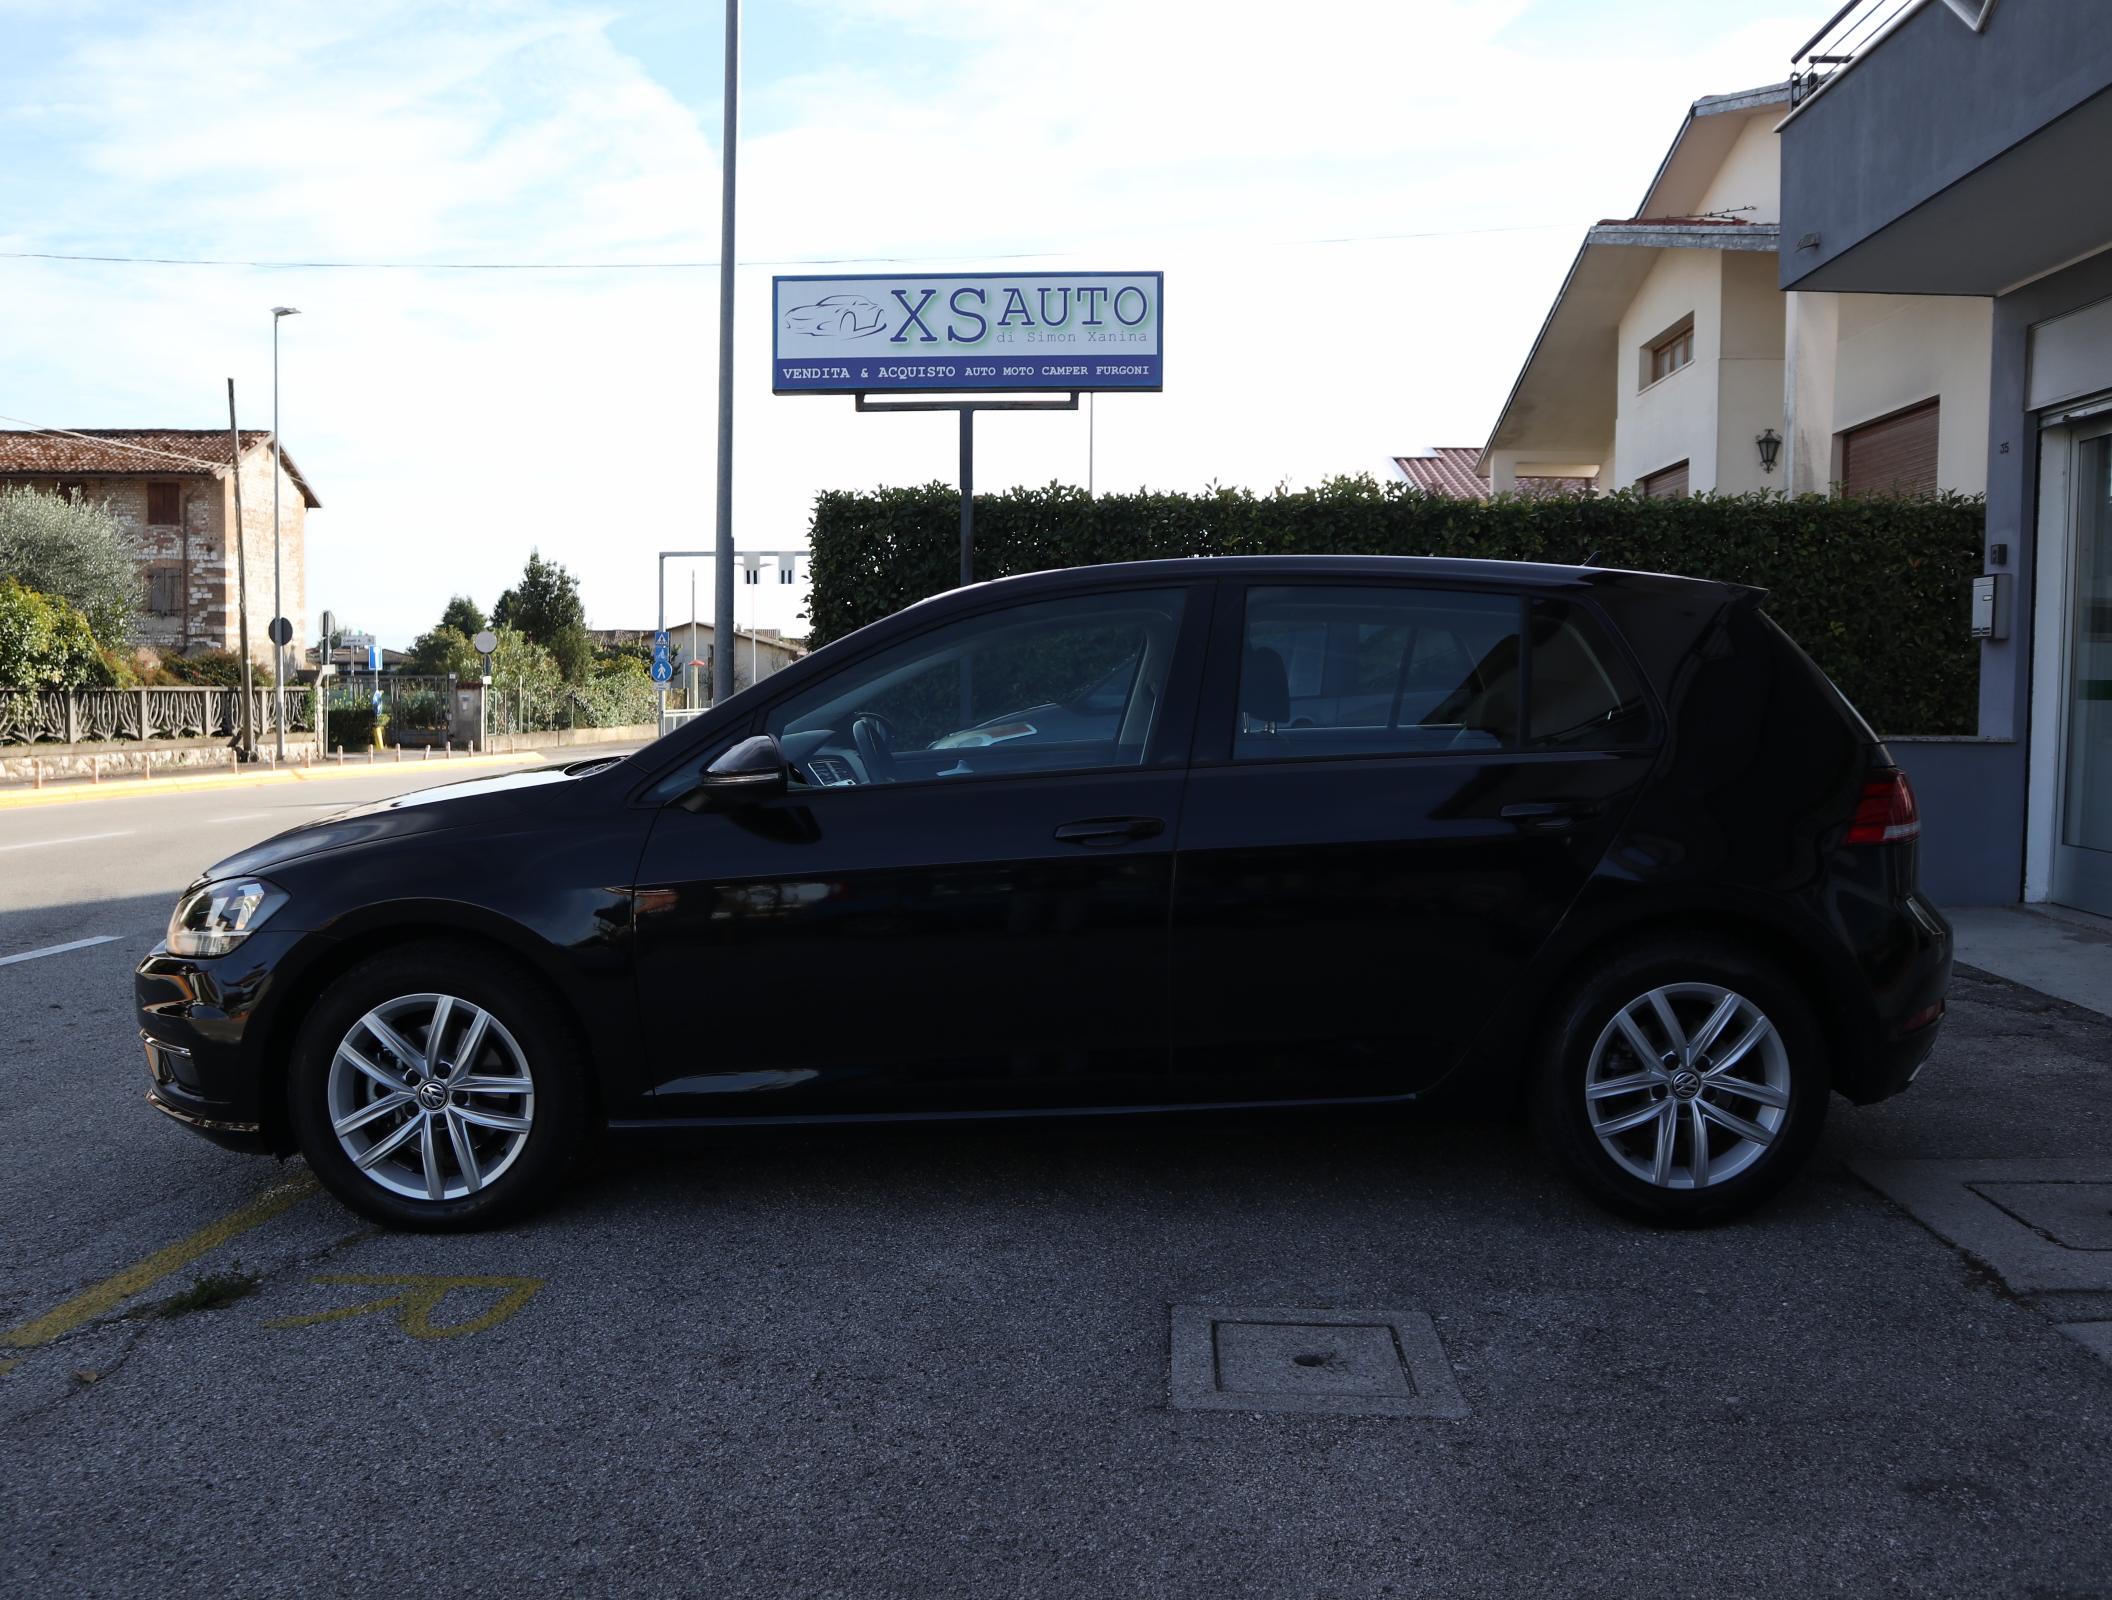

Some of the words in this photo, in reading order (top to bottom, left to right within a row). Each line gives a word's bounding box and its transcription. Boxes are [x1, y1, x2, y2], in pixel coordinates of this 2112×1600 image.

[996, 332, 1015, 343] di
[1027, 331, 1077, 343] Simon
[1087, 330, 1148, 342] Xanina
[782, 367, 851, 379] VENDITA
[860, 367, 869, 378] &
[878, 366, 956, 380] ACQUISTO
[964, 367, 996, 376] AUTO
[1003, 366, 1035, 376] MOTO
[1041, 366, 1089, 376] CAMPER
[1096, 365, 1150, 375] FURGONI
